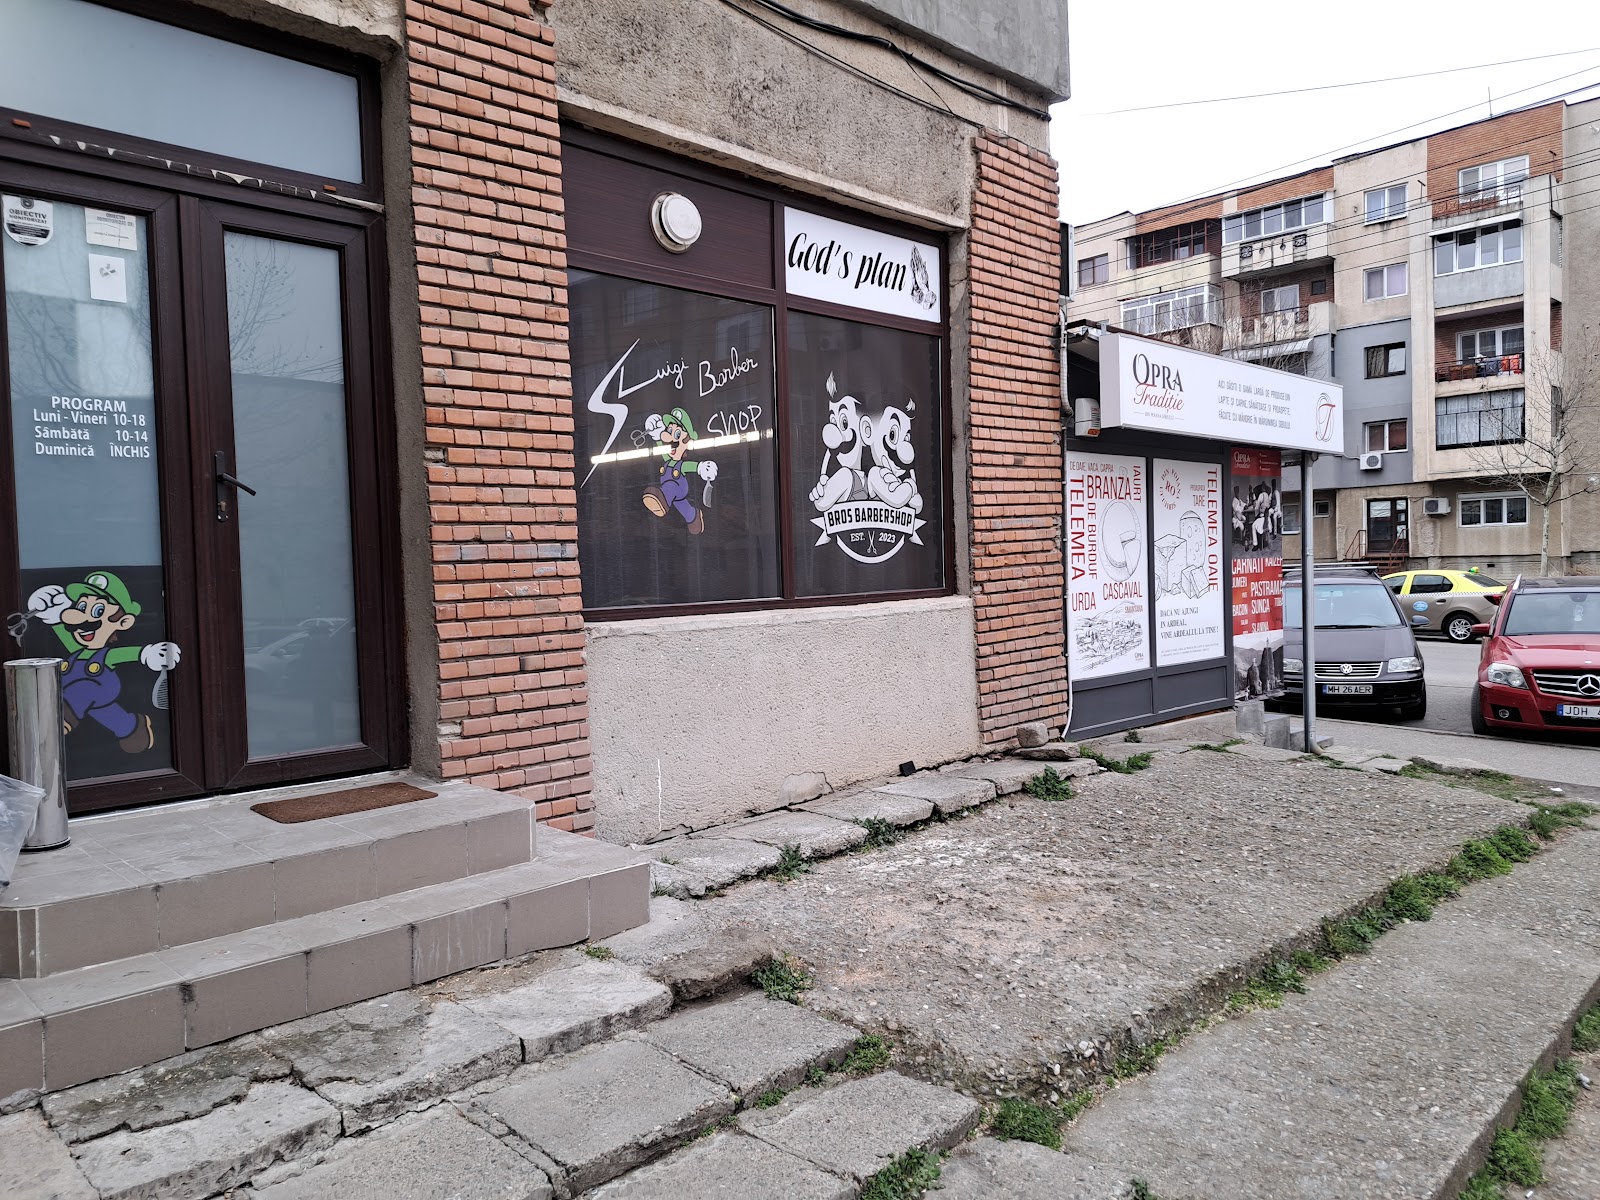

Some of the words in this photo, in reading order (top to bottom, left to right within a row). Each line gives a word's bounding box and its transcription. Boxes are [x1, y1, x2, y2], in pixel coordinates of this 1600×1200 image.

[9, 208, 47, 219] OBIECTIV
[9, 214, 47, 224] MONITORIZAT
[788, 232, 853, 279] God's
[854, 252, 906, 292] plan
[618, 357, 689, 399] Luigi
[699, 347, 758, 398] Barber
[1132, 353, 1184, 392] OPRA
[52, 396, 126, 412] PROGRAM
[1134, 384, 1184, 413] Tradiție
[34, 408, 60, 422] Luni
[71, 411, 107, 425] Vineri
[113, 414, 145, 426] 10-18
[35, 426, 90, 440] Sâmbătă
[116, 430, 148, 442] 10-14
[36, 442, 94, 457] Duminică
[110, 442, 150, 458] ÎNCHIS
[1070, 461, 1076, 470] DE
[1100, 464, 1114, 472] CAPRA
[1087, 475, 1132, 500] BRANZA
[1133, 466, 1141, 503] IAURT
[1165, 480, 1176, 496] RO
[1088, 503, 1096, 520] DE
[1208, 468, 1217, 547] TELEMEA
[828, 508, 852, 527] BROS
[854, 508, 912, 527] BARBERSHOP
[1070, 475, 1085, 580] TELEMEA
[850, 533, 865, 542] EST.
[879, 533, 896, 543] 2023
[1088, 524, 1097, 579] BURDUF
[1208, 554, 1218, 592] OAIE
[1103, 582, 1142, 600] CASCAVAL
[1072, 592, 1096, 611] URDA
[1233, 604, 1248, 616] BACON
[1252, 599, 1270, 614] SUNCA
[1182, 606, 1198, 615] AJUNGI
[1174, 628, 1198, 638] ARDEALUL
[1565, 706, 1588, 716] JDH
